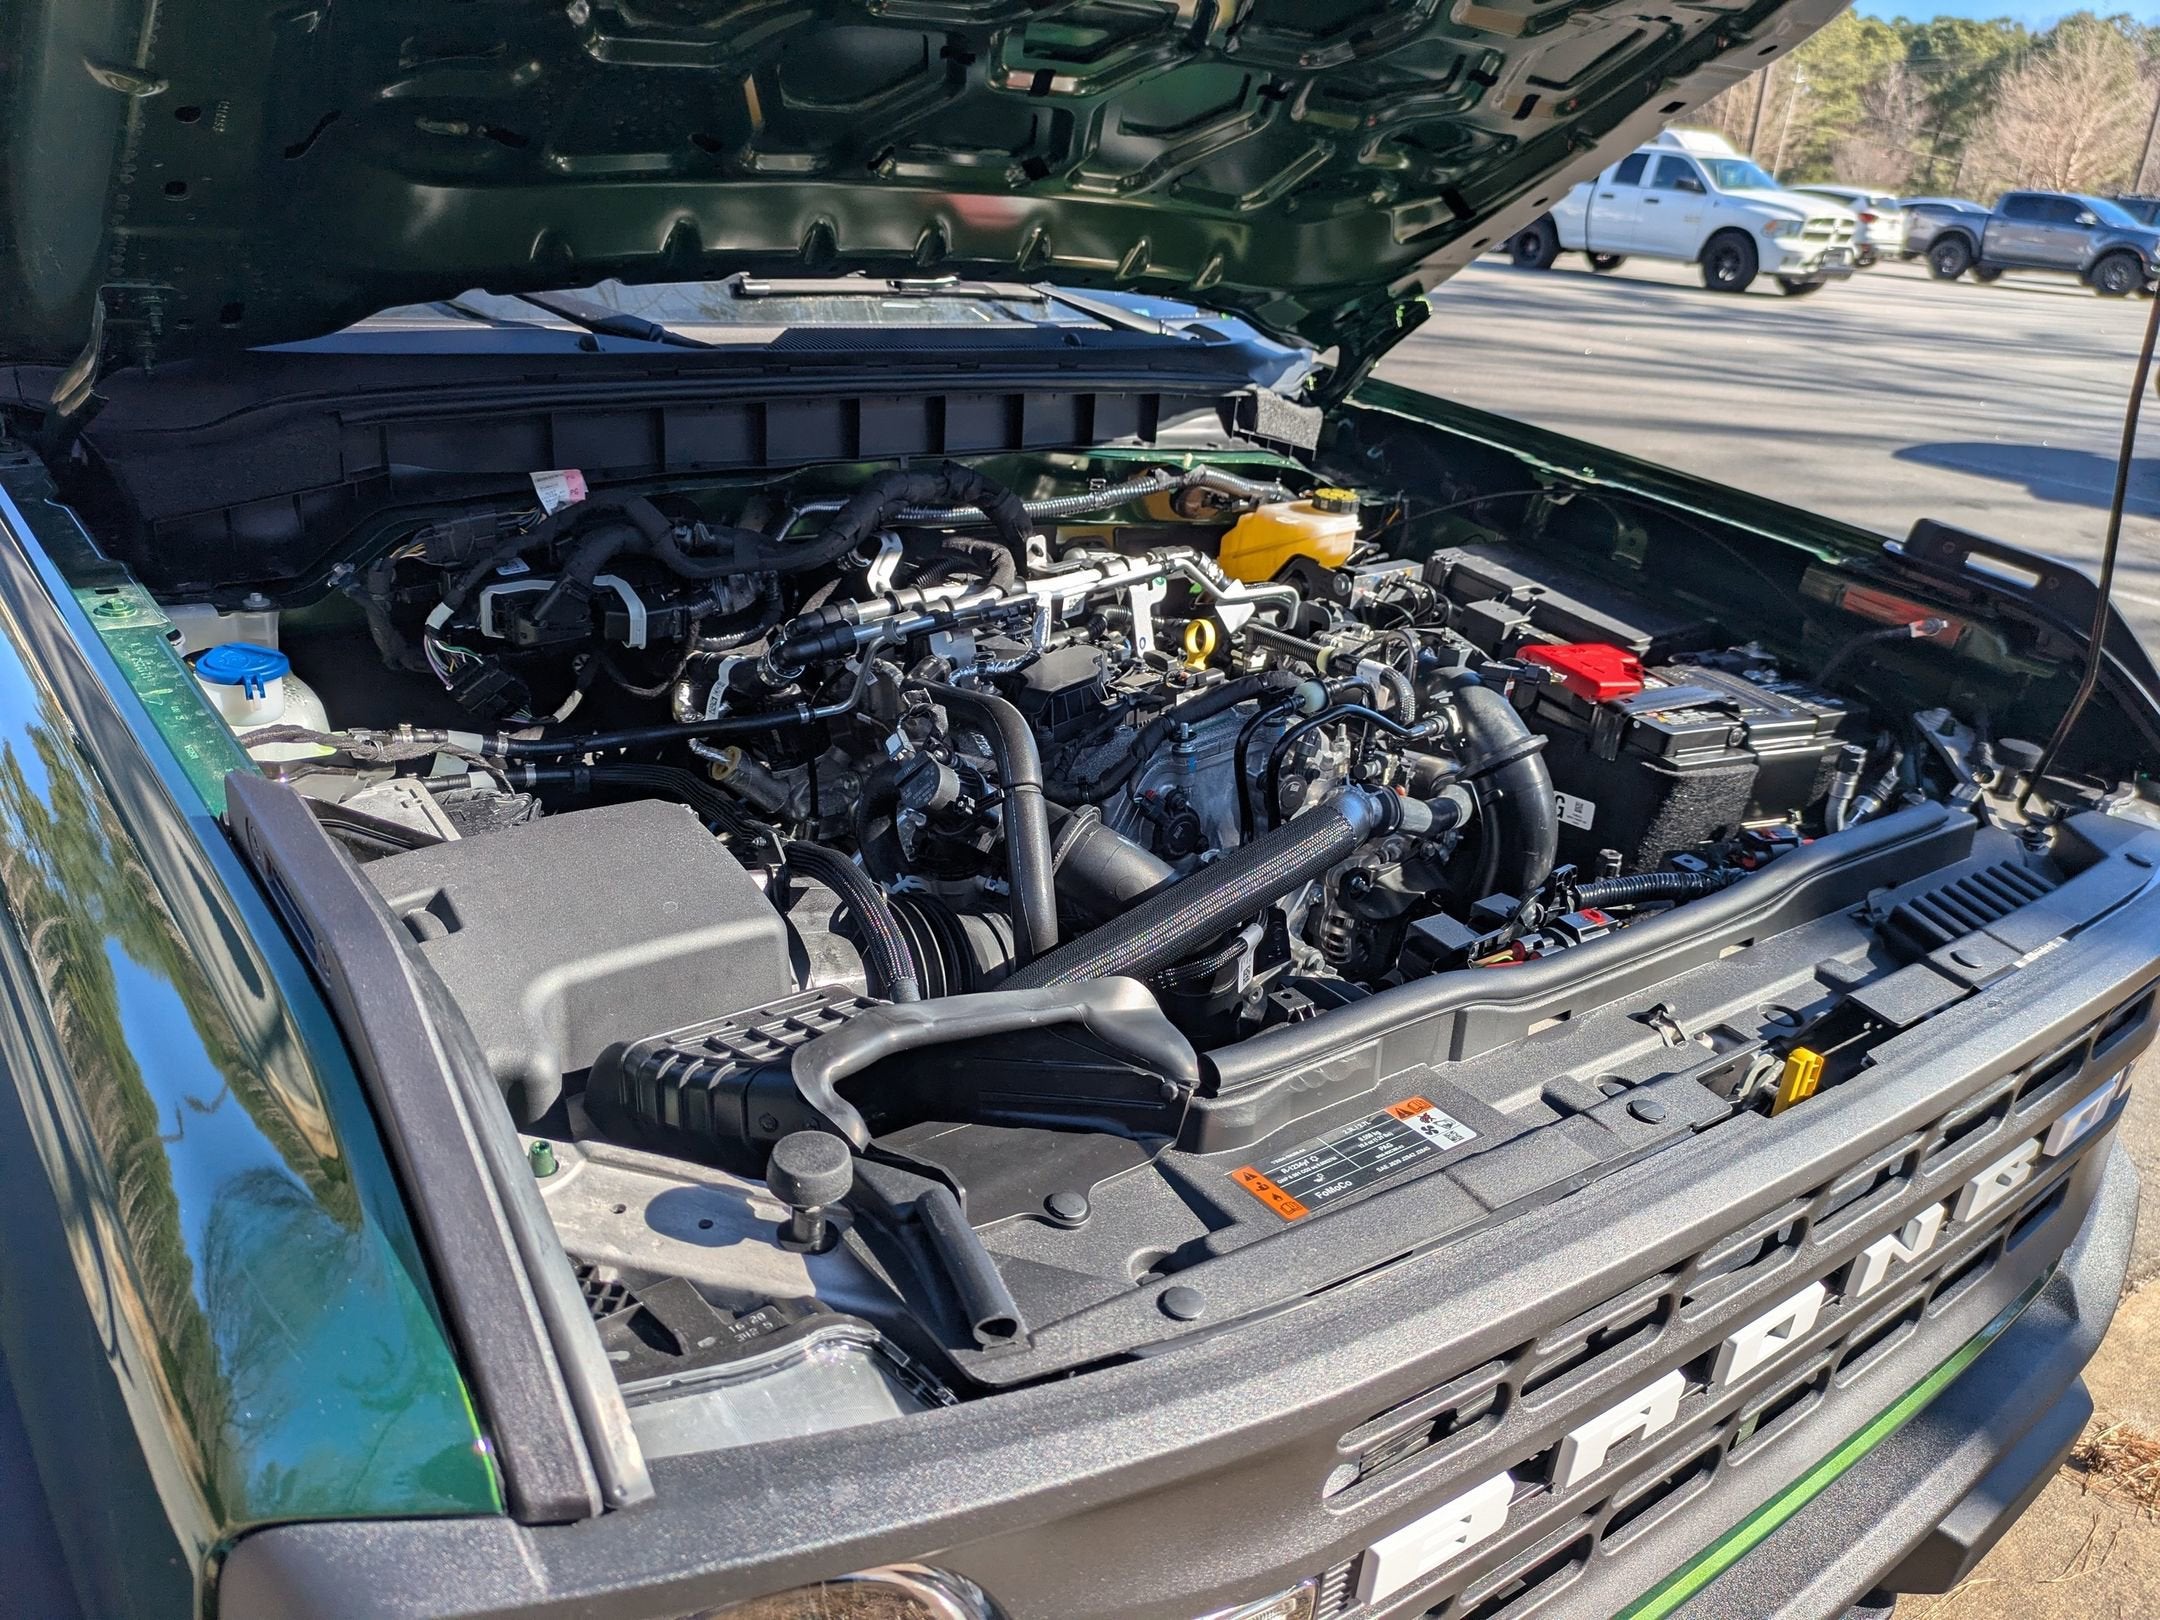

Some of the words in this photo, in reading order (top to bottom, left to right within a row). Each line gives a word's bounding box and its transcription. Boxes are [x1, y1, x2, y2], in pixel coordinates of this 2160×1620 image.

[1378, 1142, 1394, 1151] PAG
[1280, 1159, 1310, 1174] R-1234yf
[1376, 1164, 1390, 1172] SAE
[1314, 1180, 1353, 1199] FoMoCo
[1355, 1070, 2121, 1605] BRONCO
